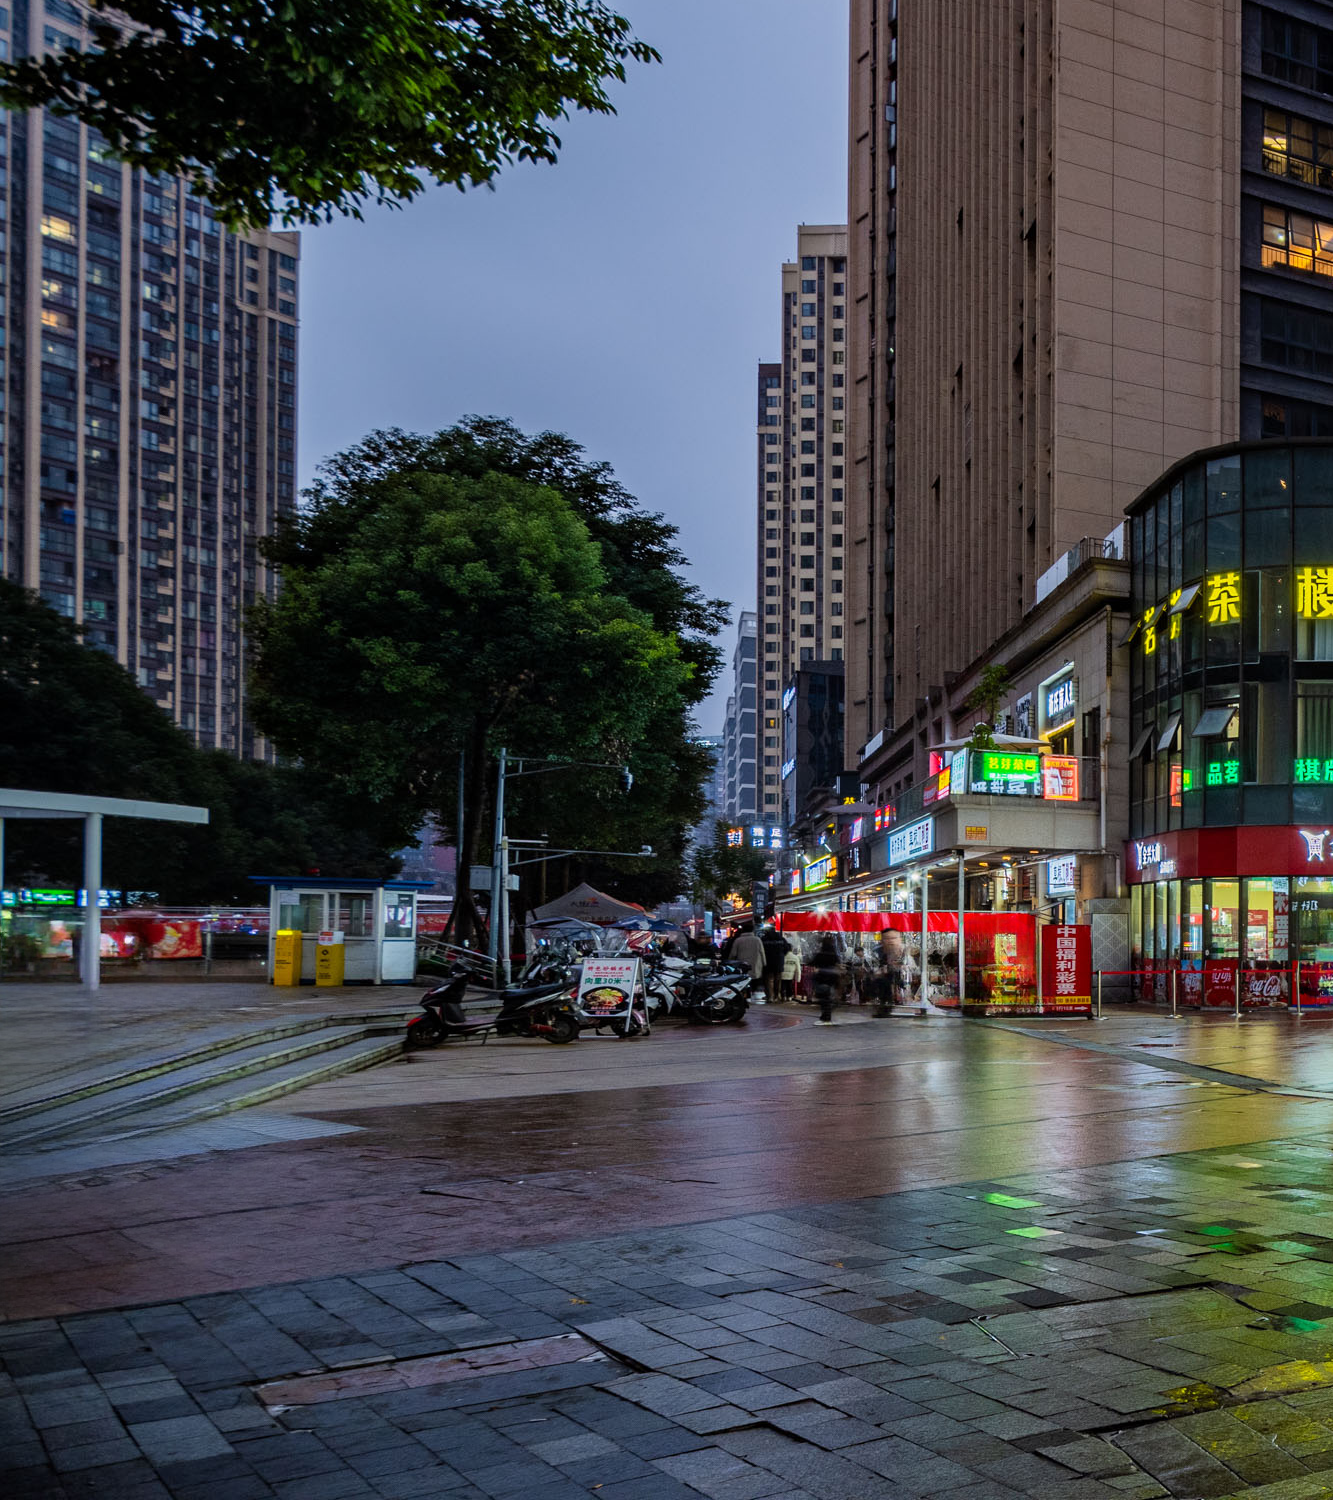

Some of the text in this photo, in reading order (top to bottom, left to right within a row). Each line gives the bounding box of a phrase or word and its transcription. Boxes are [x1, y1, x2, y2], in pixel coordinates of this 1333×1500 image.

[1208, 761, 1240, 786] 品茗
[1055, 925, 1077, 995] 中国福利彩票
